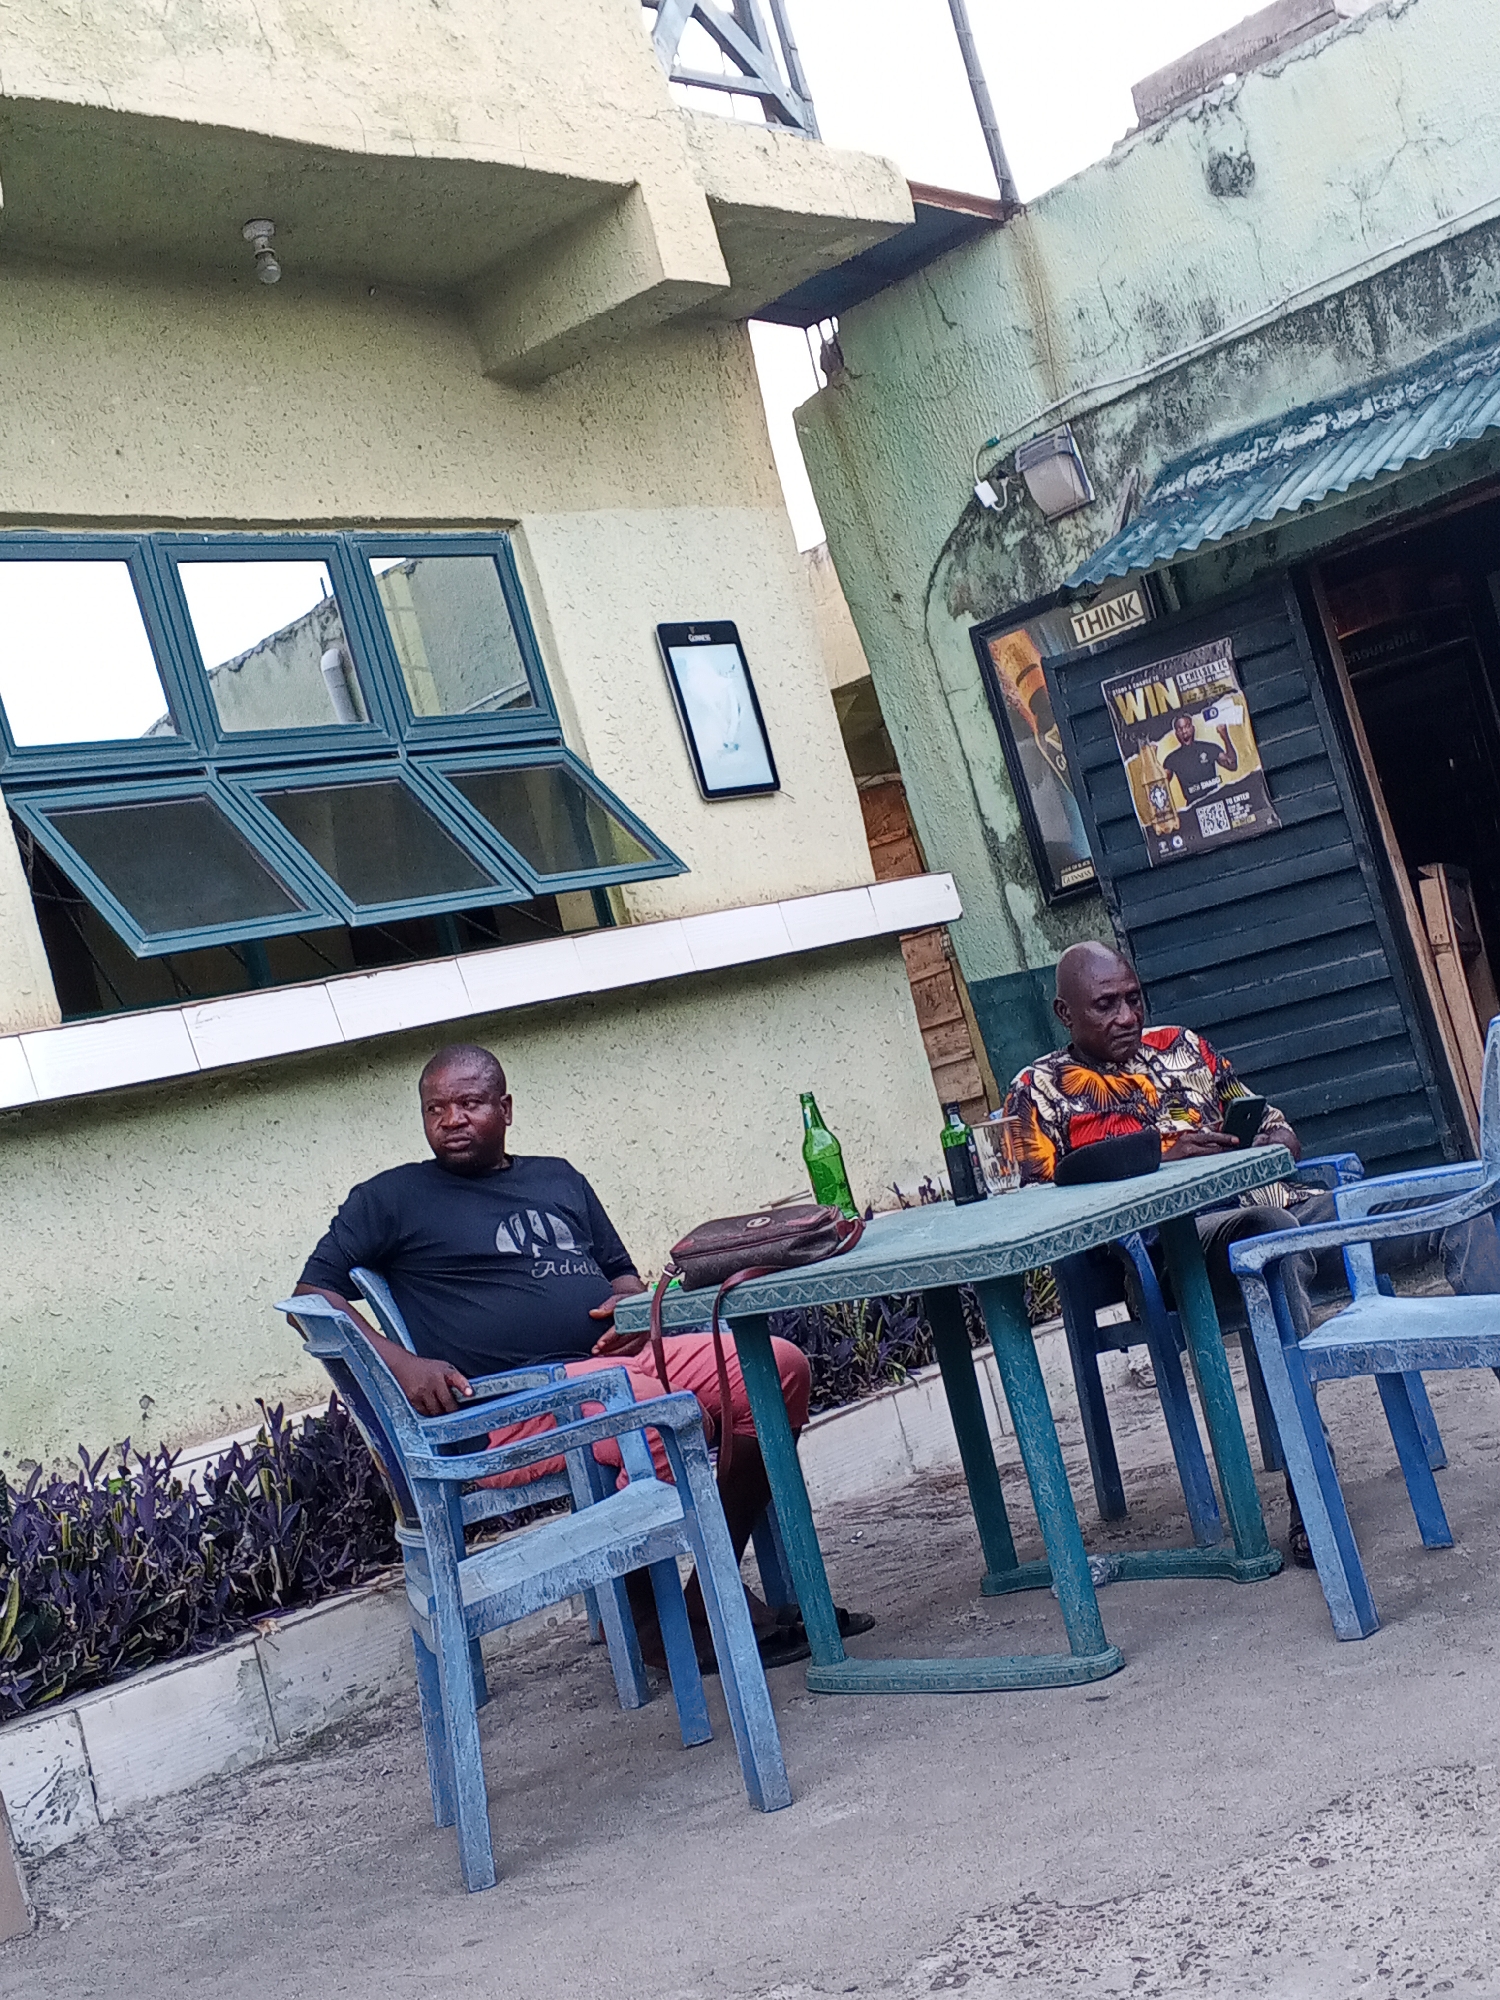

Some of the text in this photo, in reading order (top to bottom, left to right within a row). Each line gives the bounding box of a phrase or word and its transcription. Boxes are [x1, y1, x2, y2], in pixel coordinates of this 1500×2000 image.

[1074, 593, 1140, 638] THINK
[1184, 663, 1217, 682] CHELSEA
[1114, 676, 1182, 726] WIN
